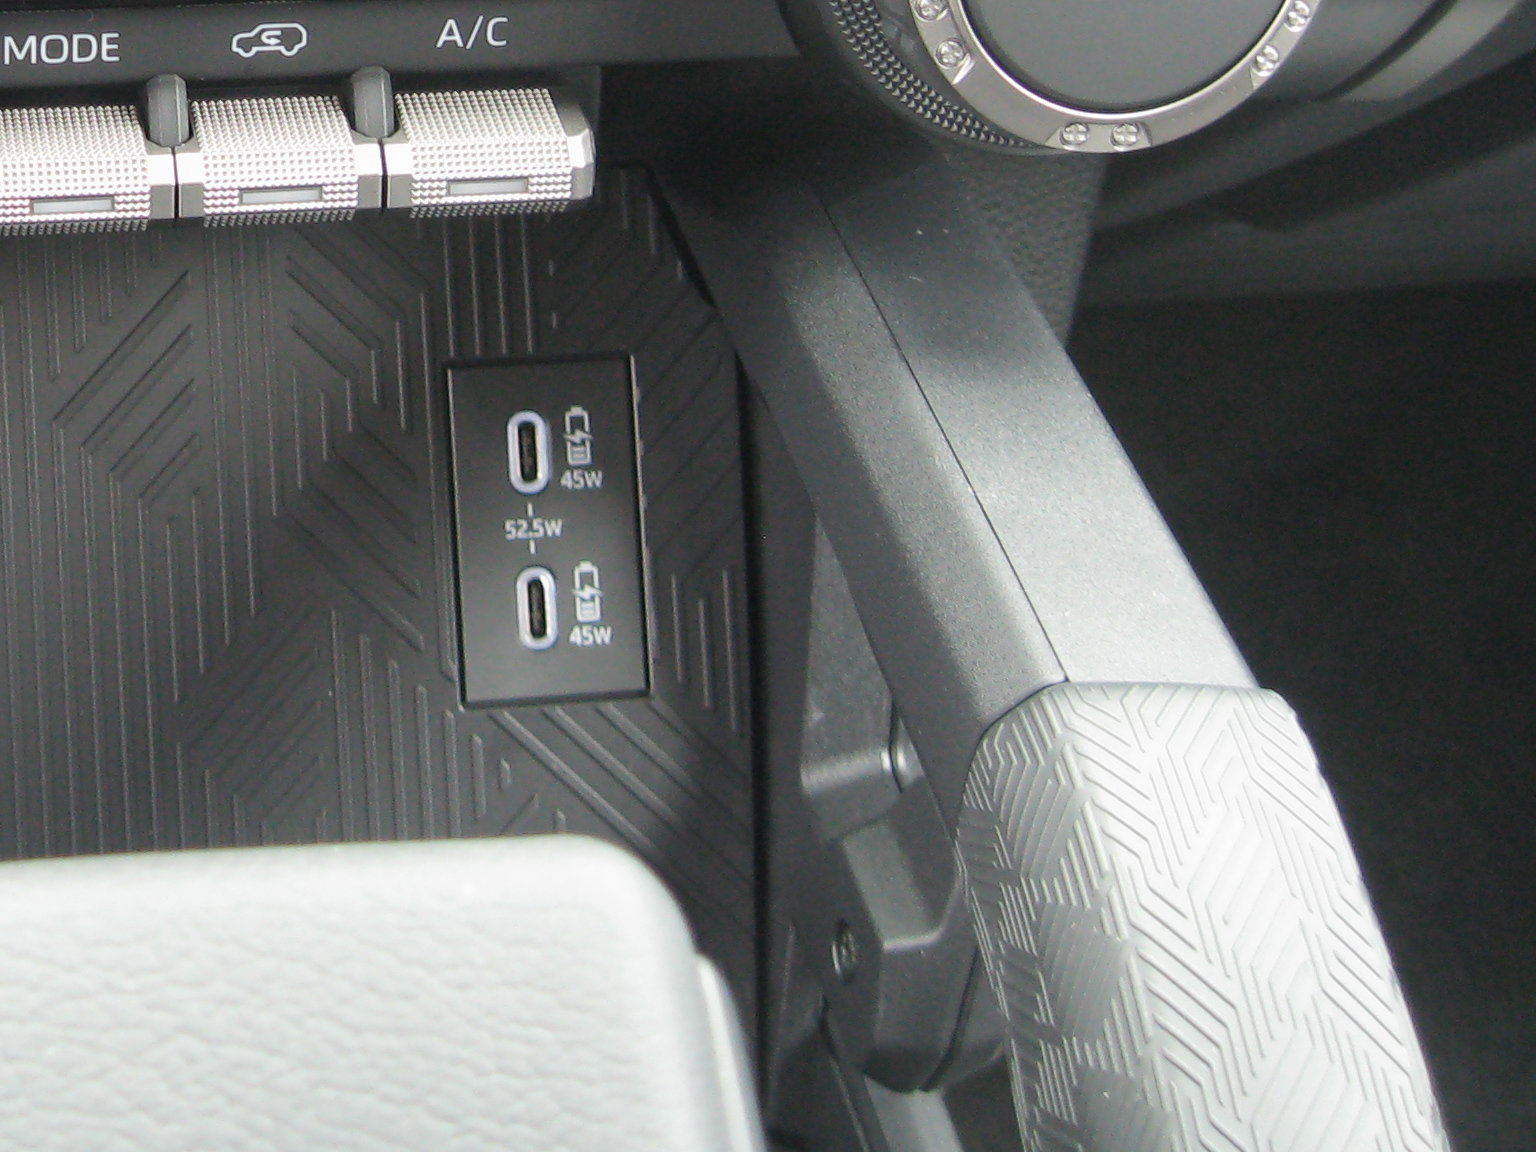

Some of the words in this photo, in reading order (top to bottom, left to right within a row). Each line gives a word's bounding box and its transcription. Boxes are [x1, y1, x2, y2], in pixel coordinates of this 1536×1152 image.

[435, 13, 509, 50] A/C
[2, 32, 121, 65] MODE
[560, 469, 603, 489] 45W
[504, 518, 563, 538] 52.5W
[569, 625, 613, 646] 45W
